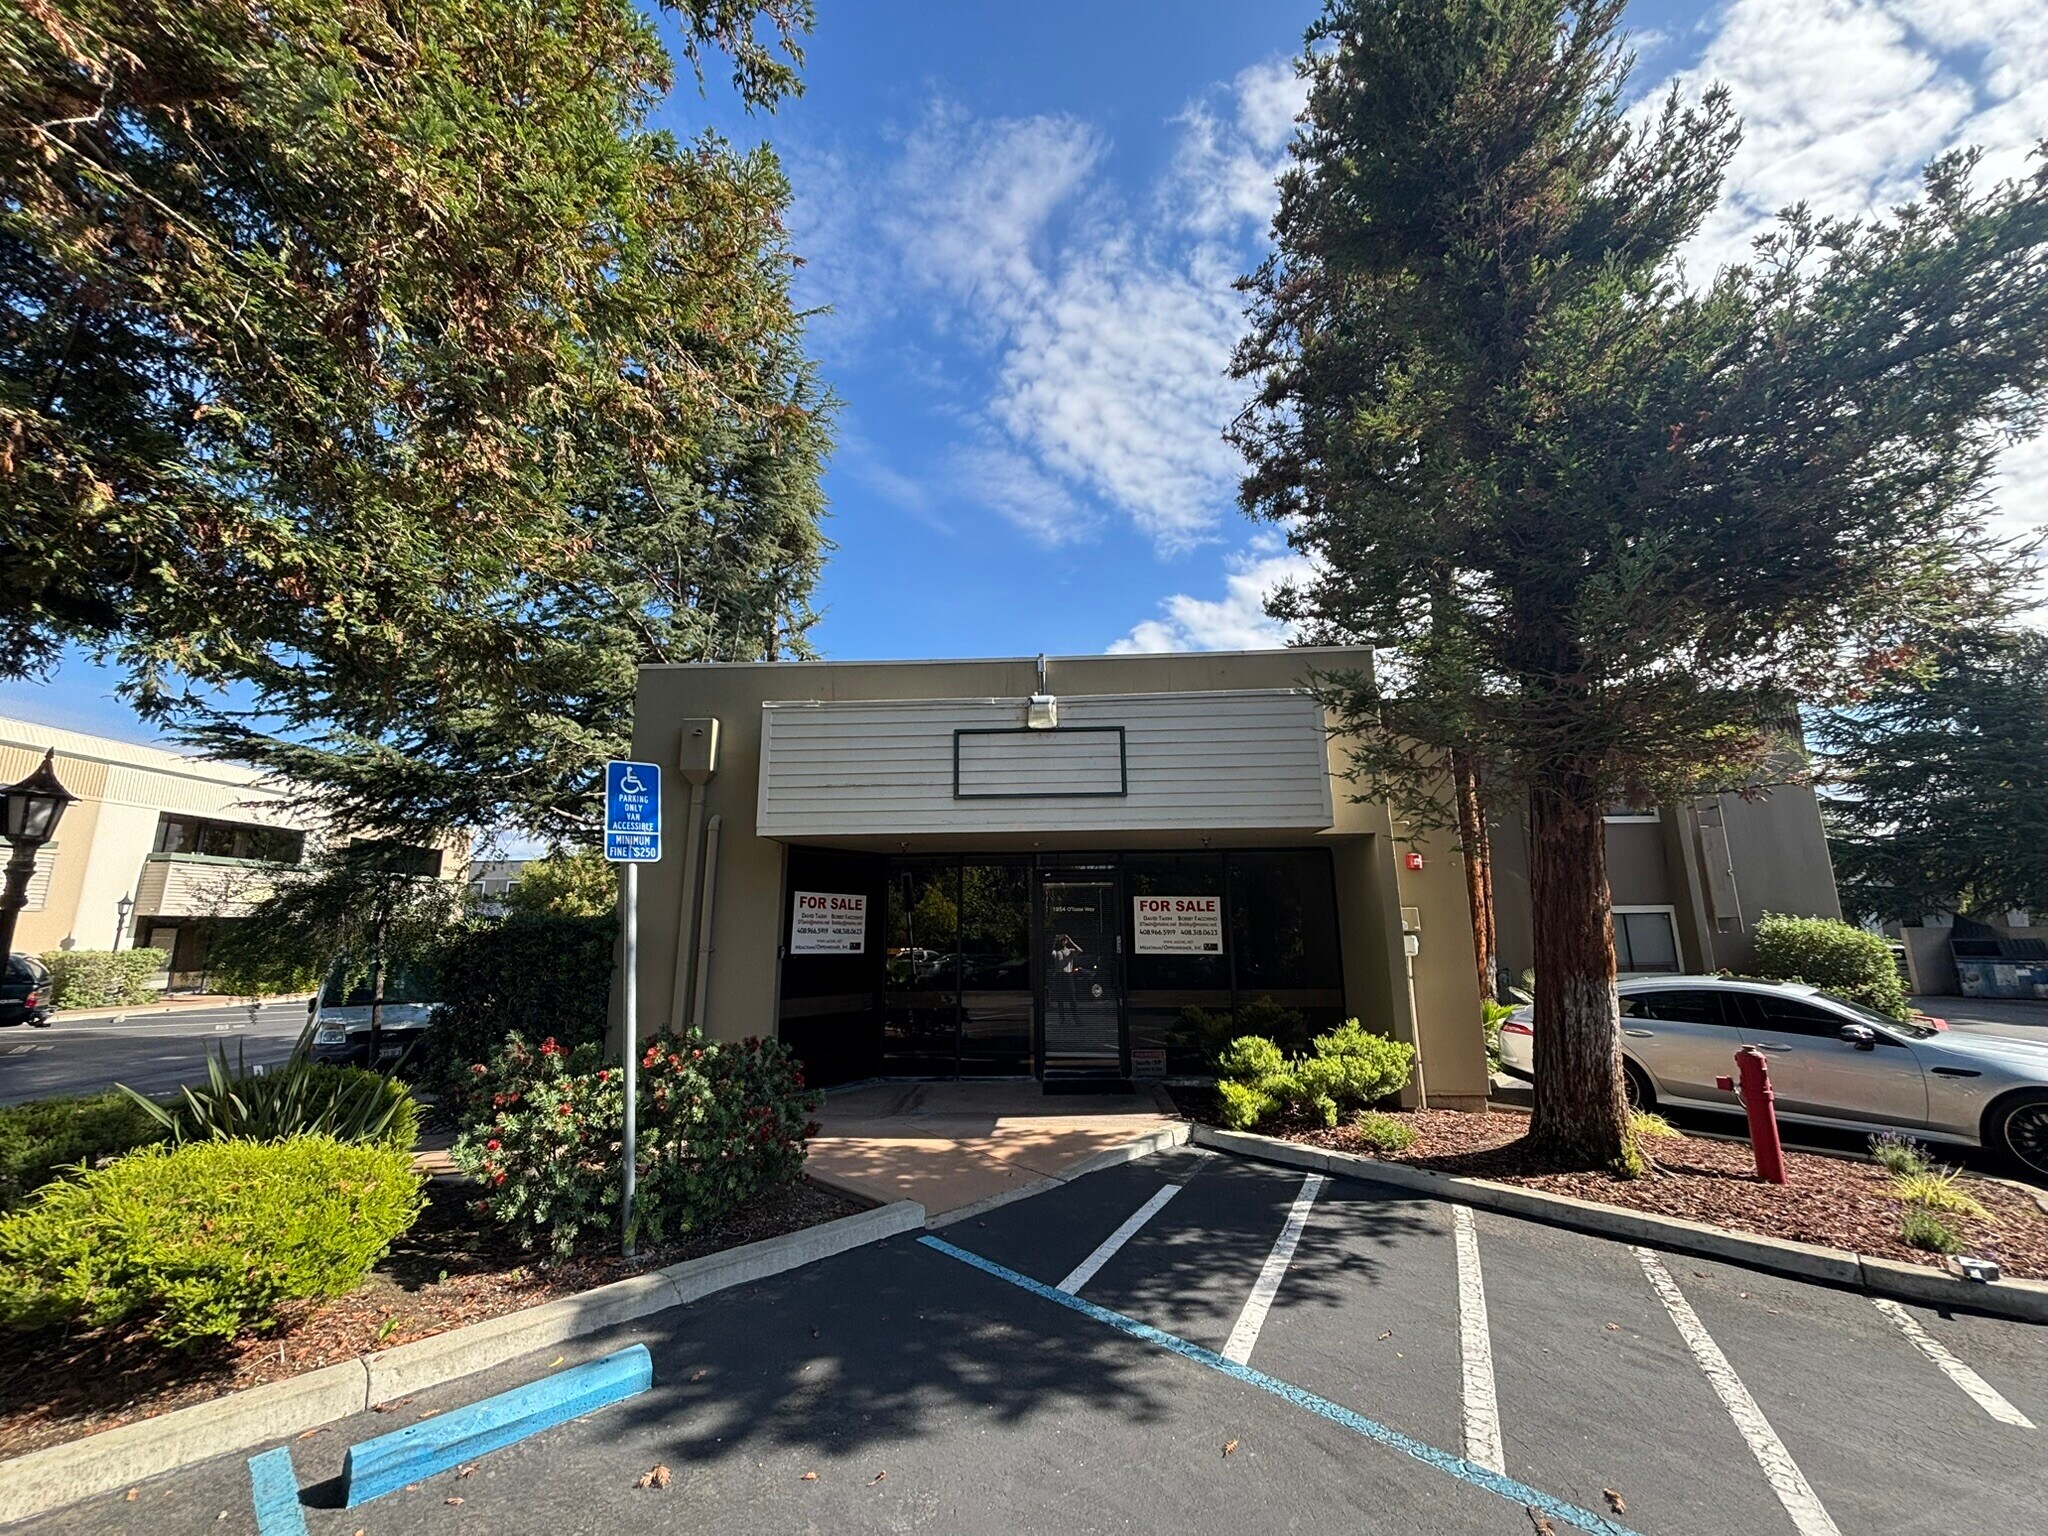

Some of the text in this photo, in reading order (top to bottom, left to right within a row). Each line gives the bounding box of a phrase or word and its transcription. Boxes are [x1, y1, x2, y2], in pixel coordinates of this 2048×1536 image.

[619, 794, 649, 803] PARKING
[625, 804, 643, 812] ONLY
[627, 813, 640, 821] VAN
[612, 821, 654, 831] ACCESSIBLE
[616, 835, 650, 845] MINIMUM
[610, 847, 656, 857] FINE $250
[800, 896, 863, 911] FOR SALE
[1140, 900, 1216, 912] FOR SALE
